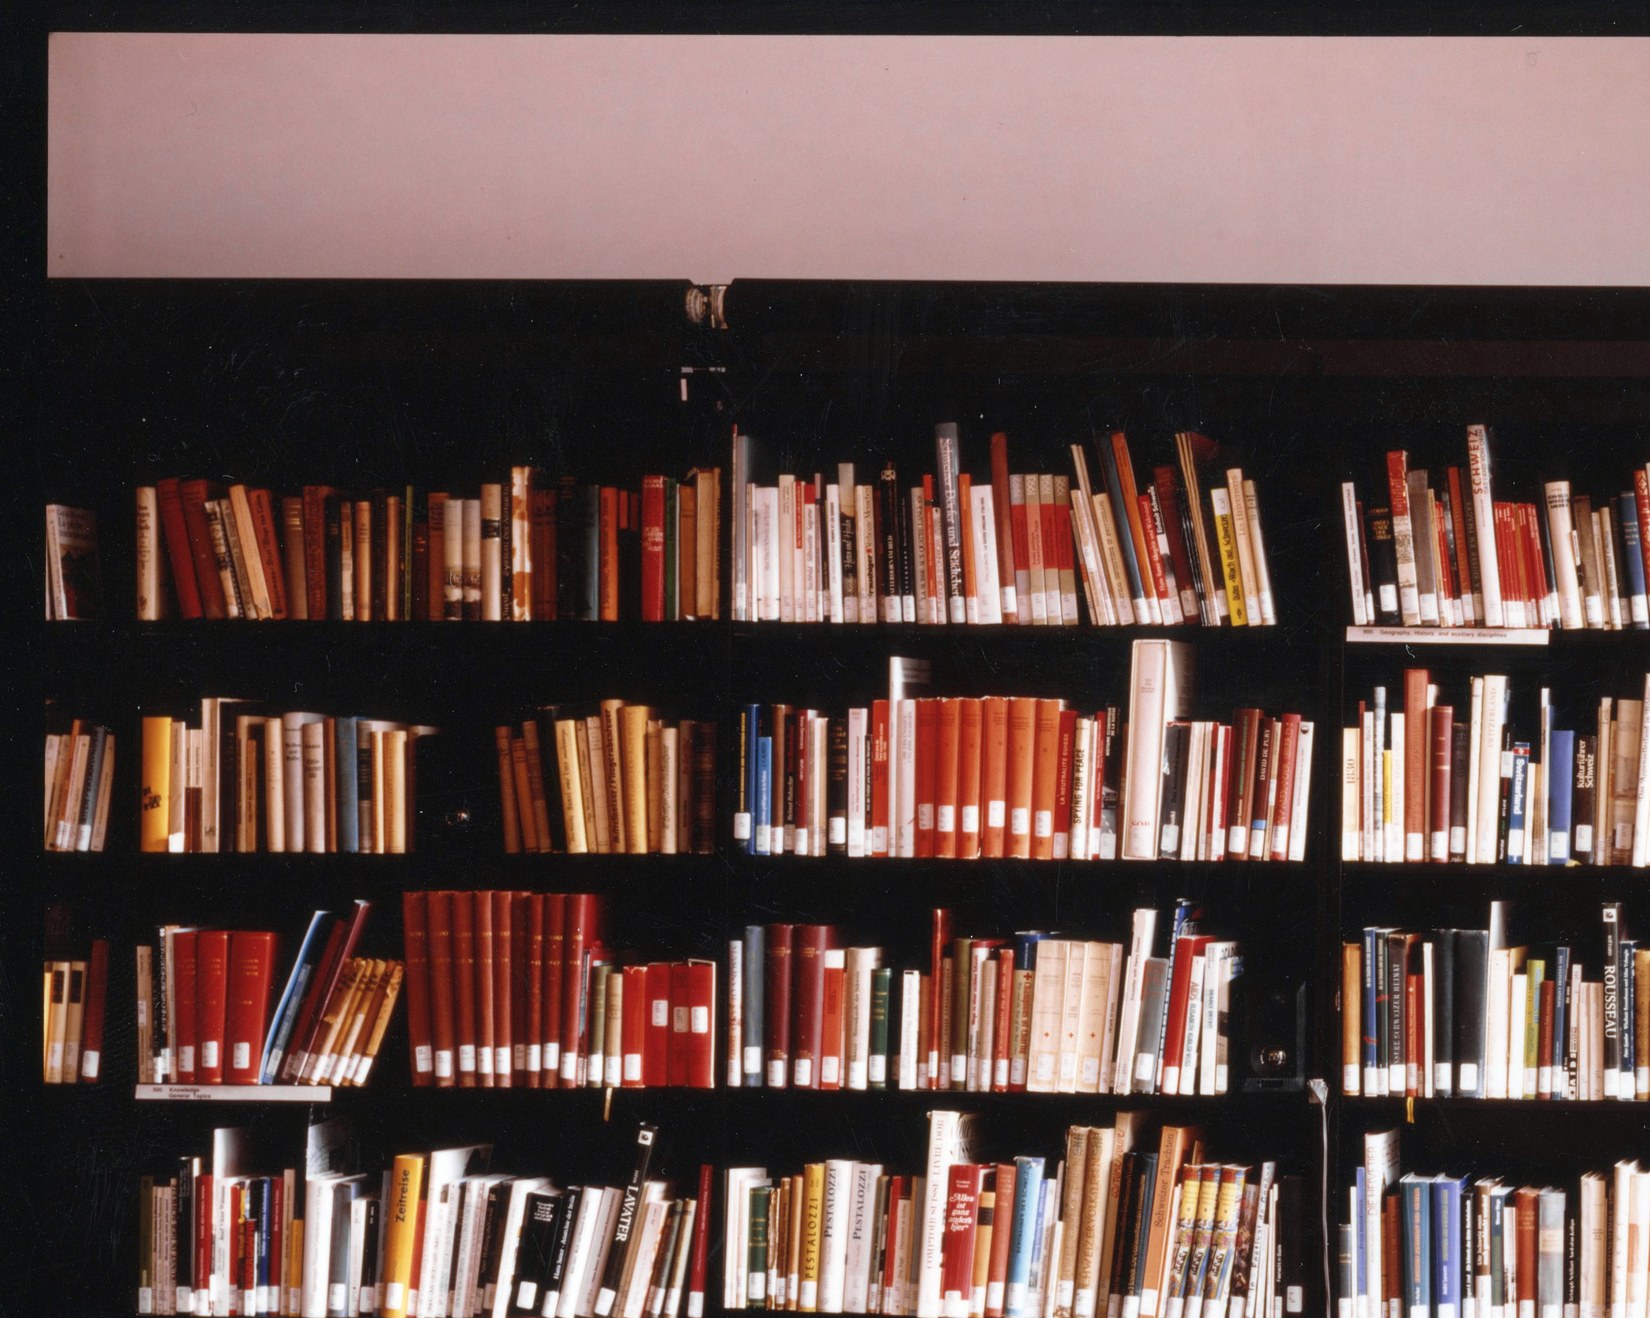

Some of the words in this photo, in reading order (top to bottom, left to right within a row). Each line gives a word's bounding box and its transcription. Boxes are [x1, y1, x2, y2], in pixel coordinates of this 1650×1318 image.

[1468, 428, 1484, 495] SCHWEIZ
[1026, 476, 1037, 496] 1993
[944, 490, 958, 524] Dörfer
[947, 526, 959, 547] und
[949, 549, 964, 598] Städtchen
[1487, 687, 1497, 748] SWITZERLAND
[604, 708, 618, 784] Fliegerabenteuer
[1062, 732, 1070, 757] SUISSE
[1261, 745, 1268, 759] DE
[1262, 728, 1270, 745] PURY
[1074, 747, 1085, 774] PEACE
[1259, 760, 1267, 781] DAVID
[1345, 758, 1356, 785] 1830
[1576, 739, 1586, 789] Kulturführer
[1585, 753, 1594, 789] Schweiz
[1073, 775, 1083, 791] FOR
[1513, 758, 1525, 815] Switzerland
[610, 789, 621, 844] Mittelholzer
[1061, 797, 1067, 806] LA
[1073, 793, 1084, 825] SPYING
[1188, 981, 1200, 1001] AIDS
[1391, 962, 1400, 992] HEIMAT
[1020, 981, 1032, 1019] Champions
[1187, 1002, 1196, 1031] ELISABETH
[1604, 964, 1617, 1039] ROUSSEAU
[931, 1144, 941, 1175] LIVRE
[1159, 1133, 1175, 1177] Trachten
[1366, 1146, 1378, 1197] HELVETIER
[395, 1168, 410, 1222] Zeitreise
[823, 1168, 838, 1239] PESTALOZZI
[851, 1170, 867, 1241] PESTALOZZI
[929, 1183, 939, 1215] SUISSE
[949, 1192, 975, 1203] Alles
[1153, 1179, 1169, 1228] Schweizer
[1366, 1199, 1378, 1216] DIE
[615, 1185, 640, 1243] LAVATER
[804, 1197, 819, 1280] PESTALOZZI
